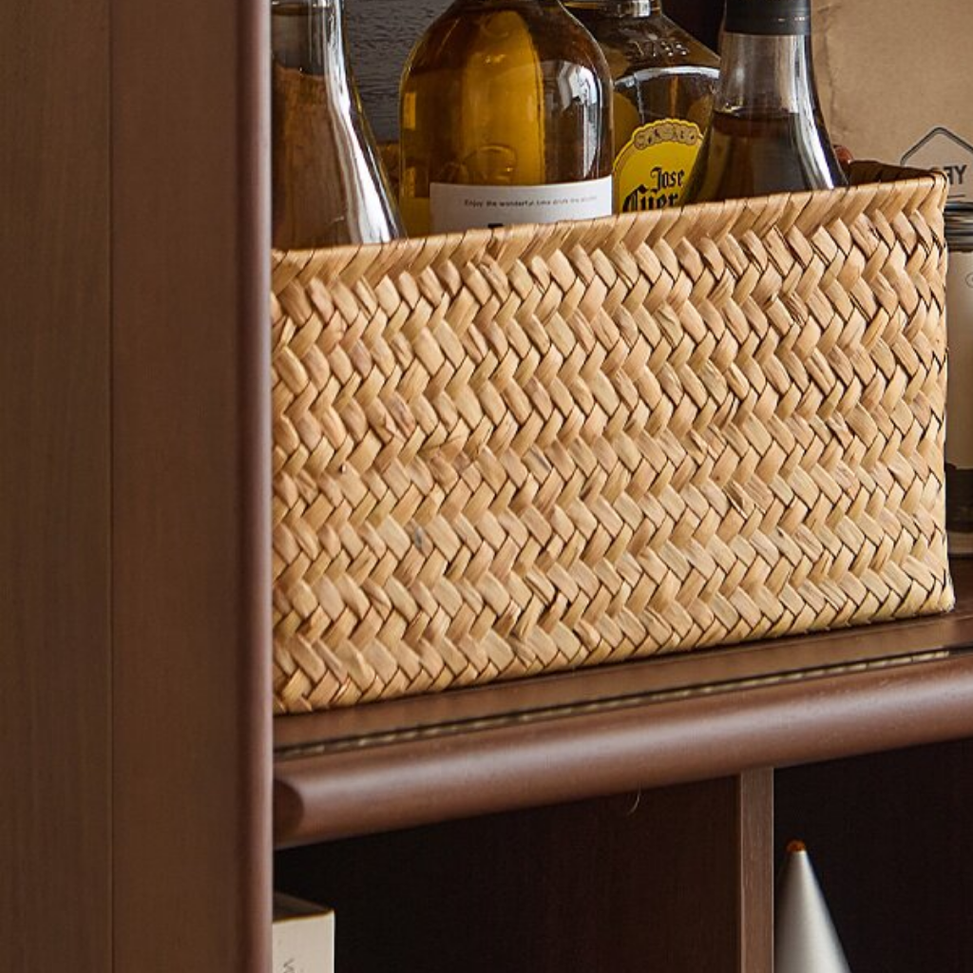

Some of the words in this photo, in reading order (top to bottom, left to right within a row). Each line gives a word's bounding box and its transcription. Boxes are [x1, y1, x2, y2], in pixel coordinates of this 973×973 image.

[650, 166, 685, 194] Jose
[464, 198, 483, 208] Enjoy
[486, 199, 497, 207] the
[499, 199, 534, 207] wonderful
[622, 184, 679, 213] Cuer
